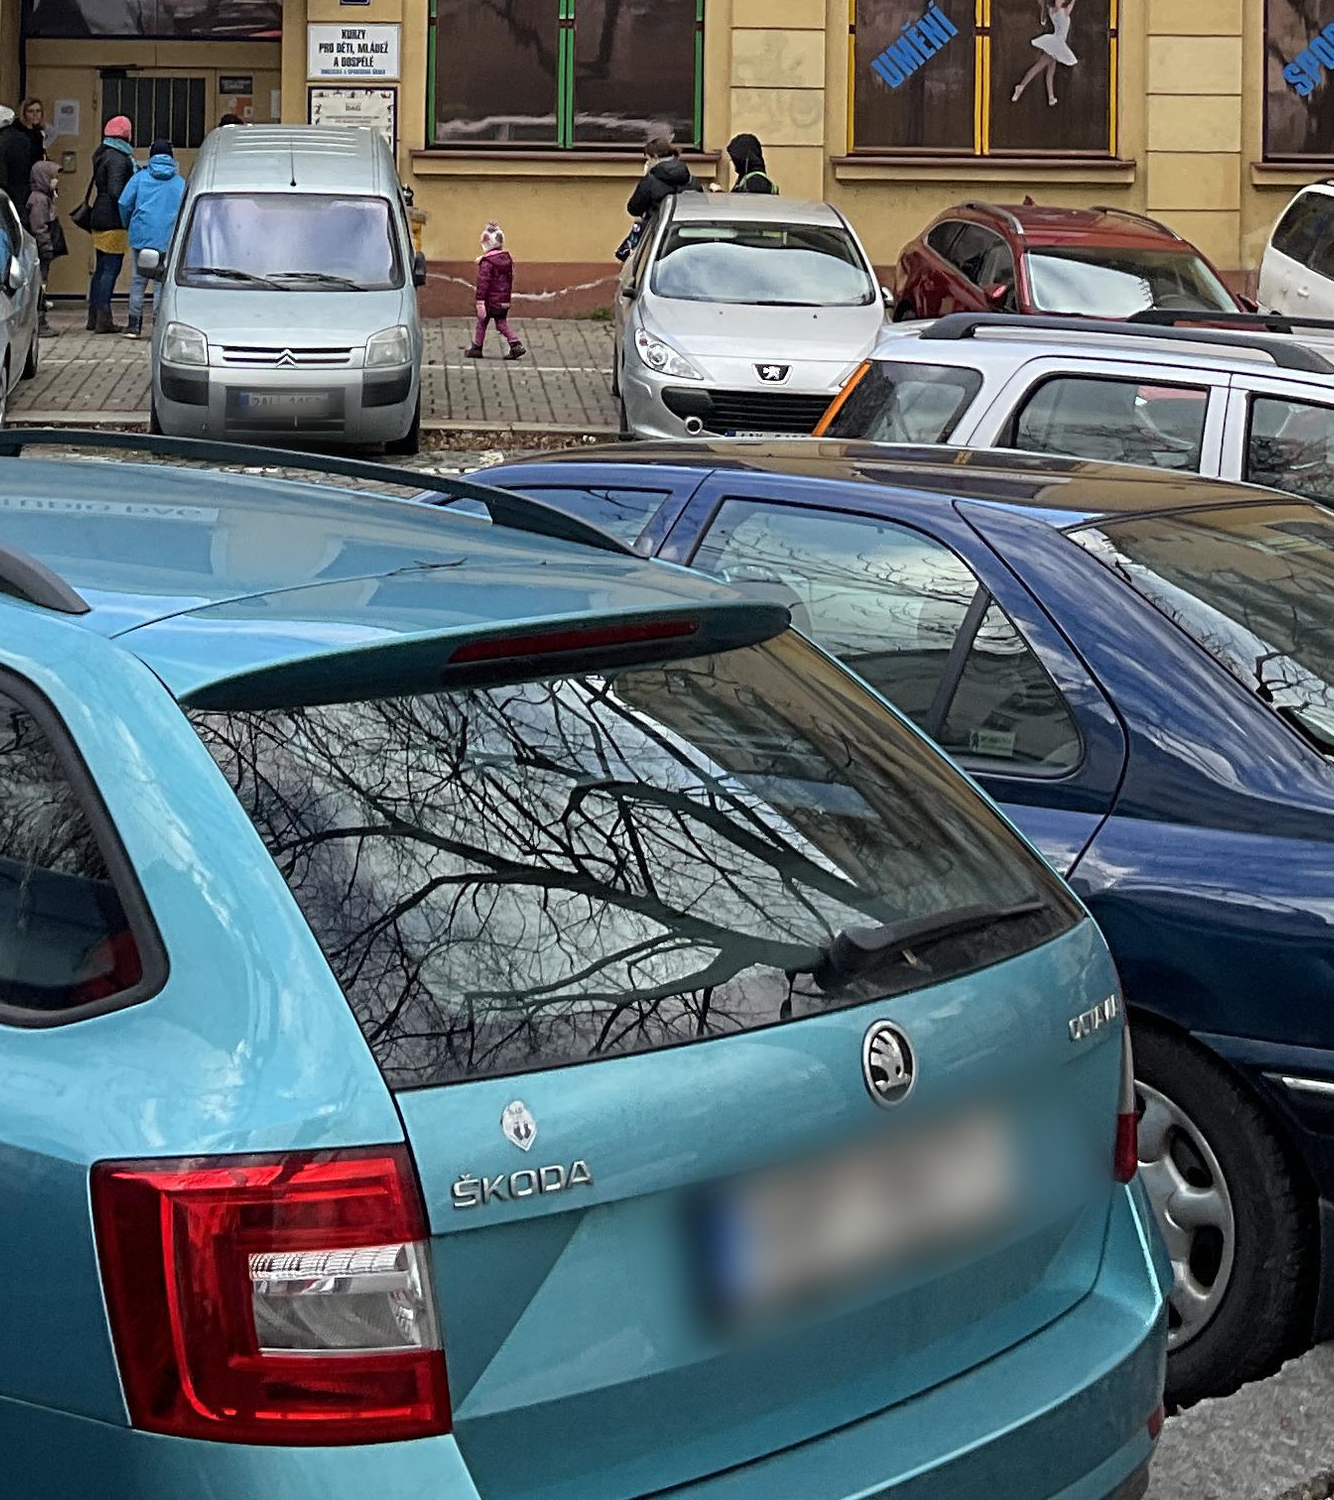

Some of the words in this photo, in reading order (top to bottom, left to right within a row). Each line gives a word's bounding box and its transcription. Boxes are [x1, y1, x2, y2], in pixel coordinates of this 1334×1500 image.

[318, 42, 334, 54] PRO
[871, 0, 959, 89] UMĚNÍ
[333, 56, 339, 68] A
[451, 1159, 593, 1209] ŠKODA
